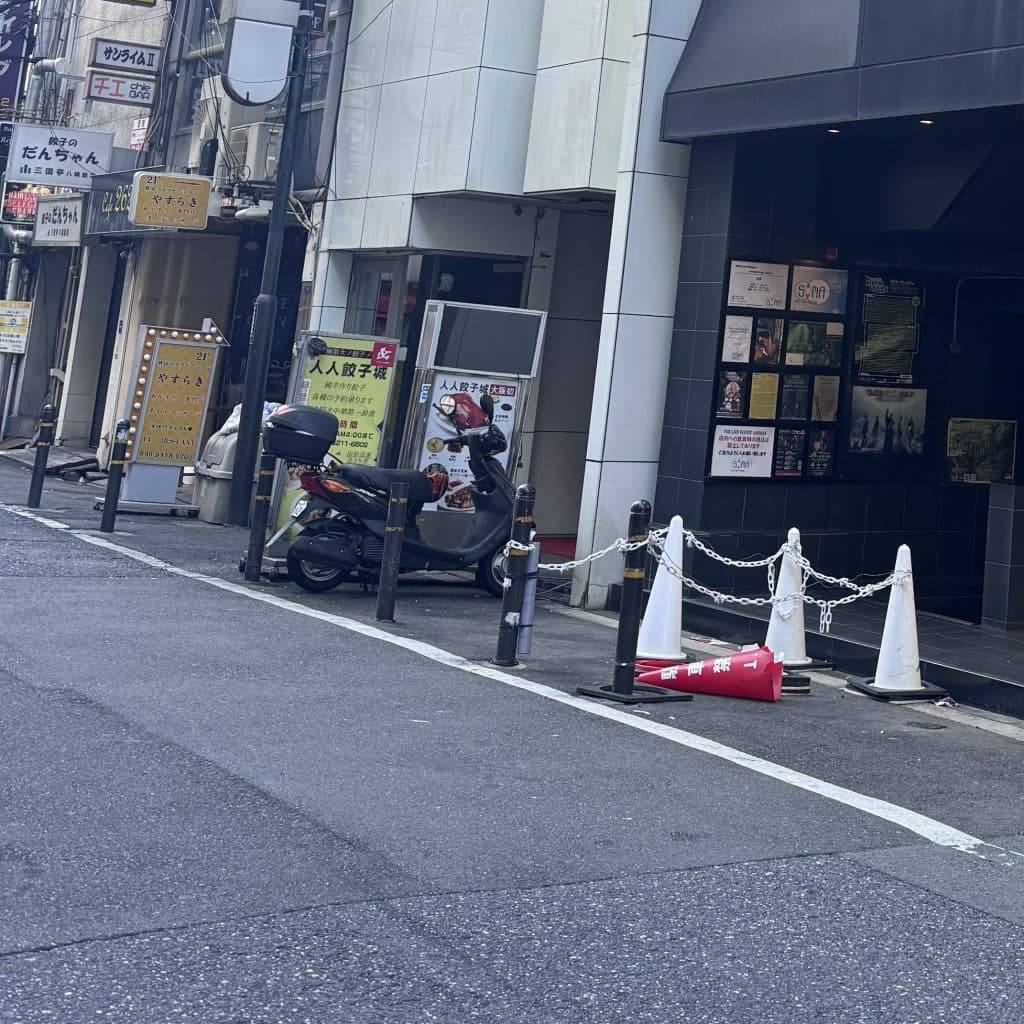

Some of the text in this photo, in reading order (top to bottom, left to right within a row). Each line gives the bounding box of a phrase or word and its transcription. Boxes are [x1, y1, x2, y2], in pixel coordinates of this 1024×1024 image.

[130, 82, 151, 92] chie
[22, 146, 99, 165] だんちゃん
[195, 352, 210, 361] 2F
[309, 359, 388, 380] 人人餃子城
